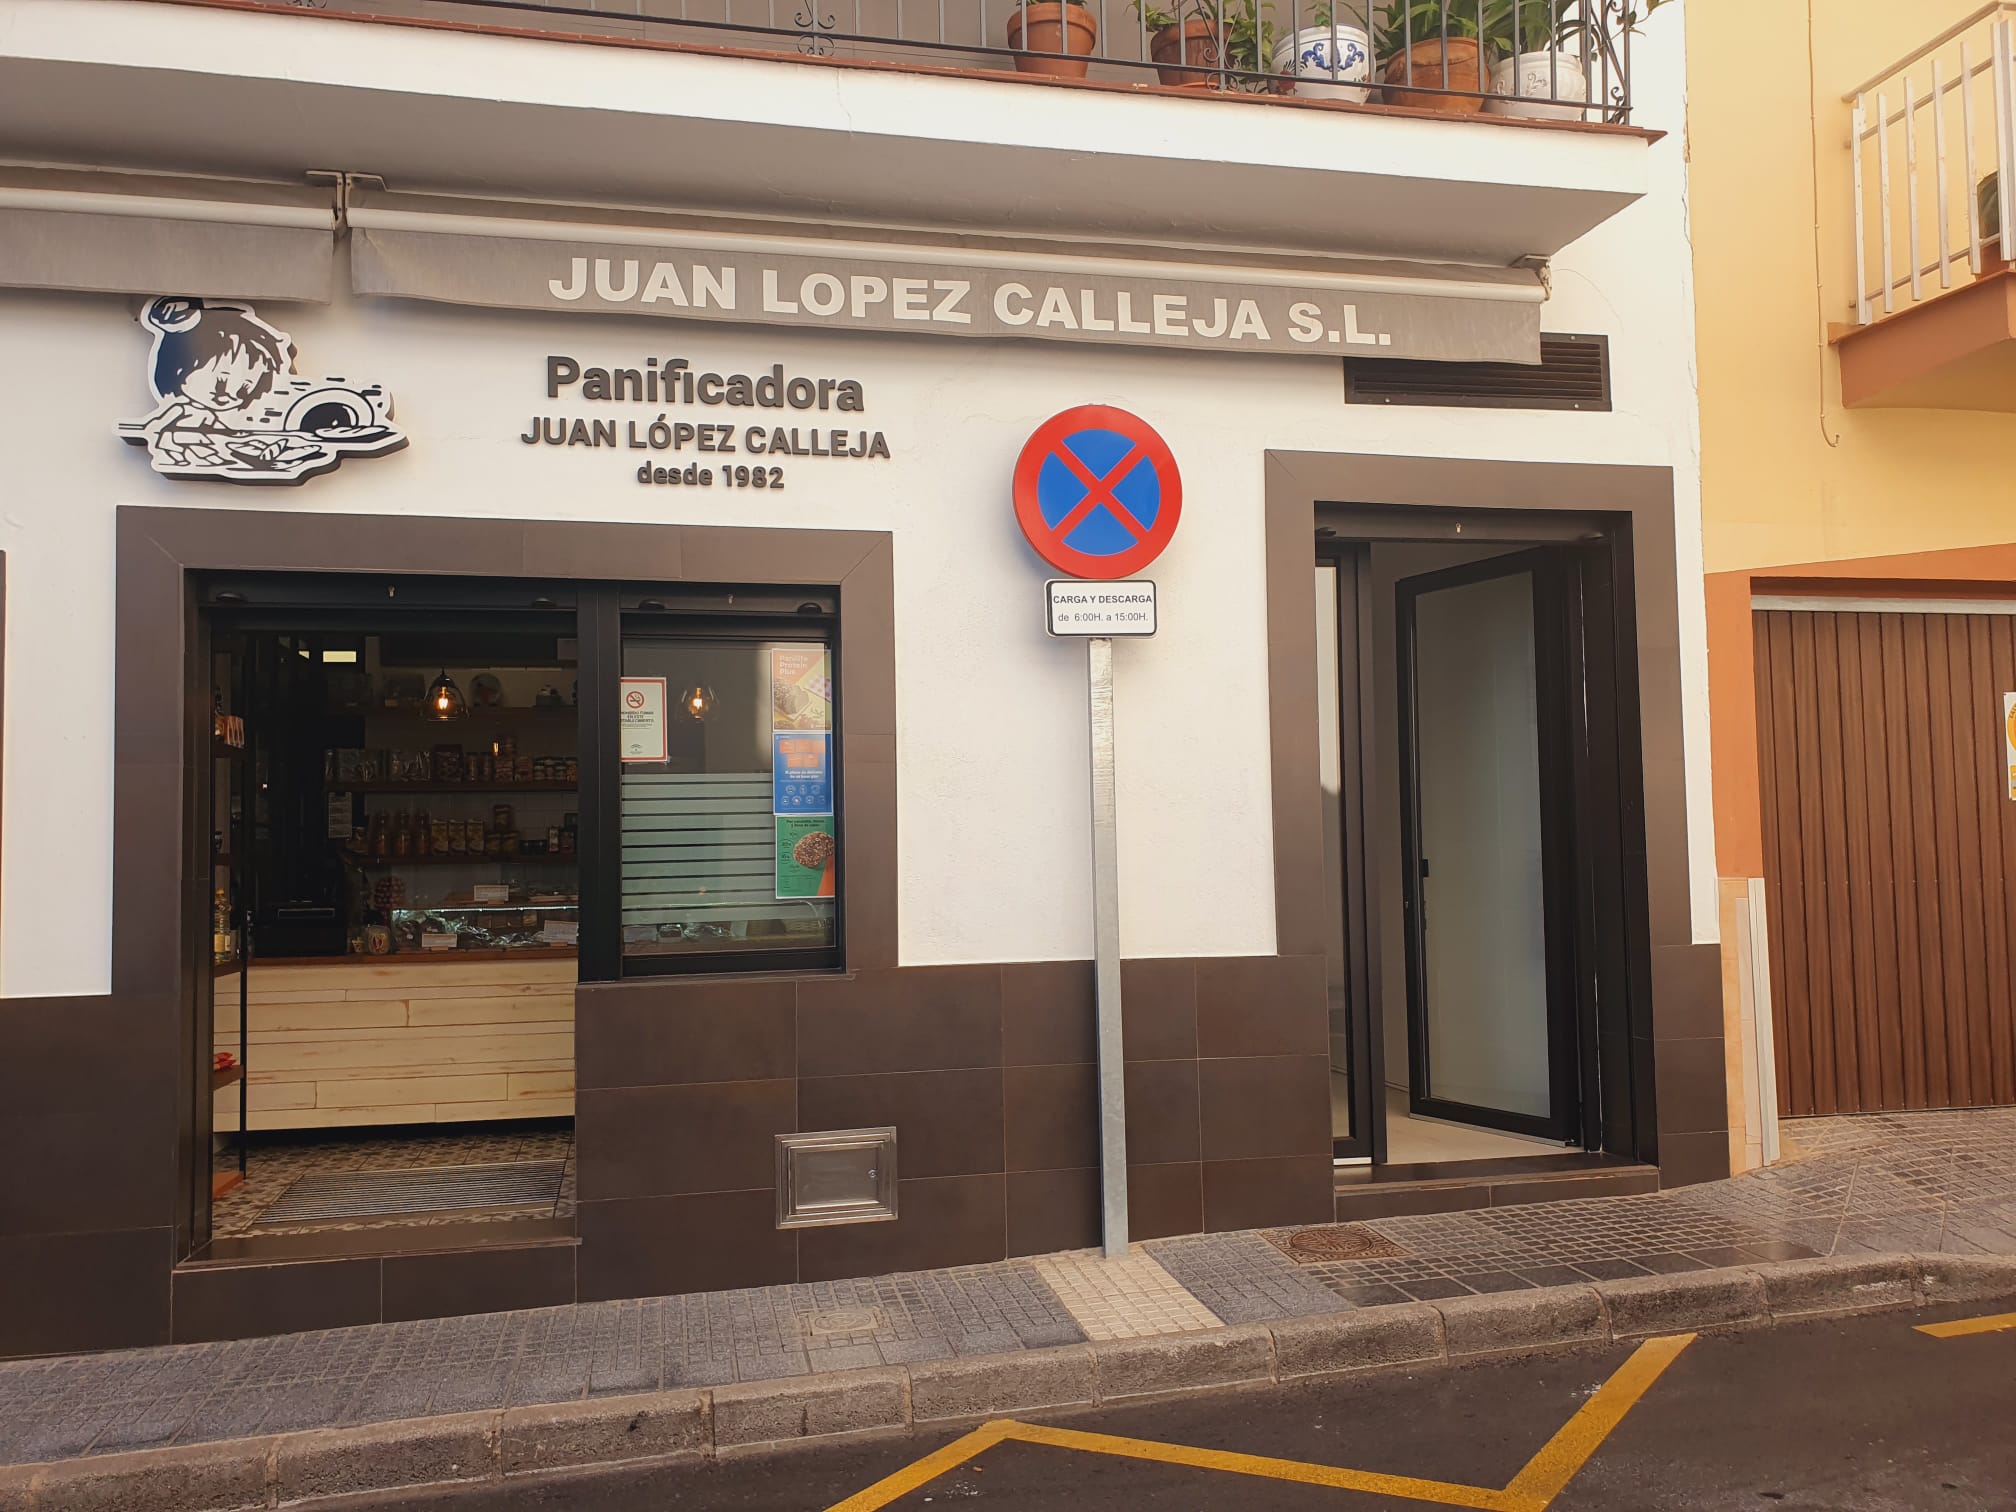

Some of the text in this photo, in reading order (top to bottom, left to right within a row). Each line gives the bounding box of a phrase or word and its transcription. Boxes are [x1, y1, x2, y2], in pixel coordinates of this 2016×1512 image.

[548, 257, 1392, 346] JUAN LOPEZ CALLEJA S.L.
[546, 355, 865, 412] Panificadora
[520, 413, 891, 459] JUAN LÓPEZ CALLEJA
[636, 461, 785, 489] desde 1982
[1053, 595, 1152, 604] CARGA Y DESCARGA
[1058, 612, 1149, 622] de 6:00H. a 15:00H.
